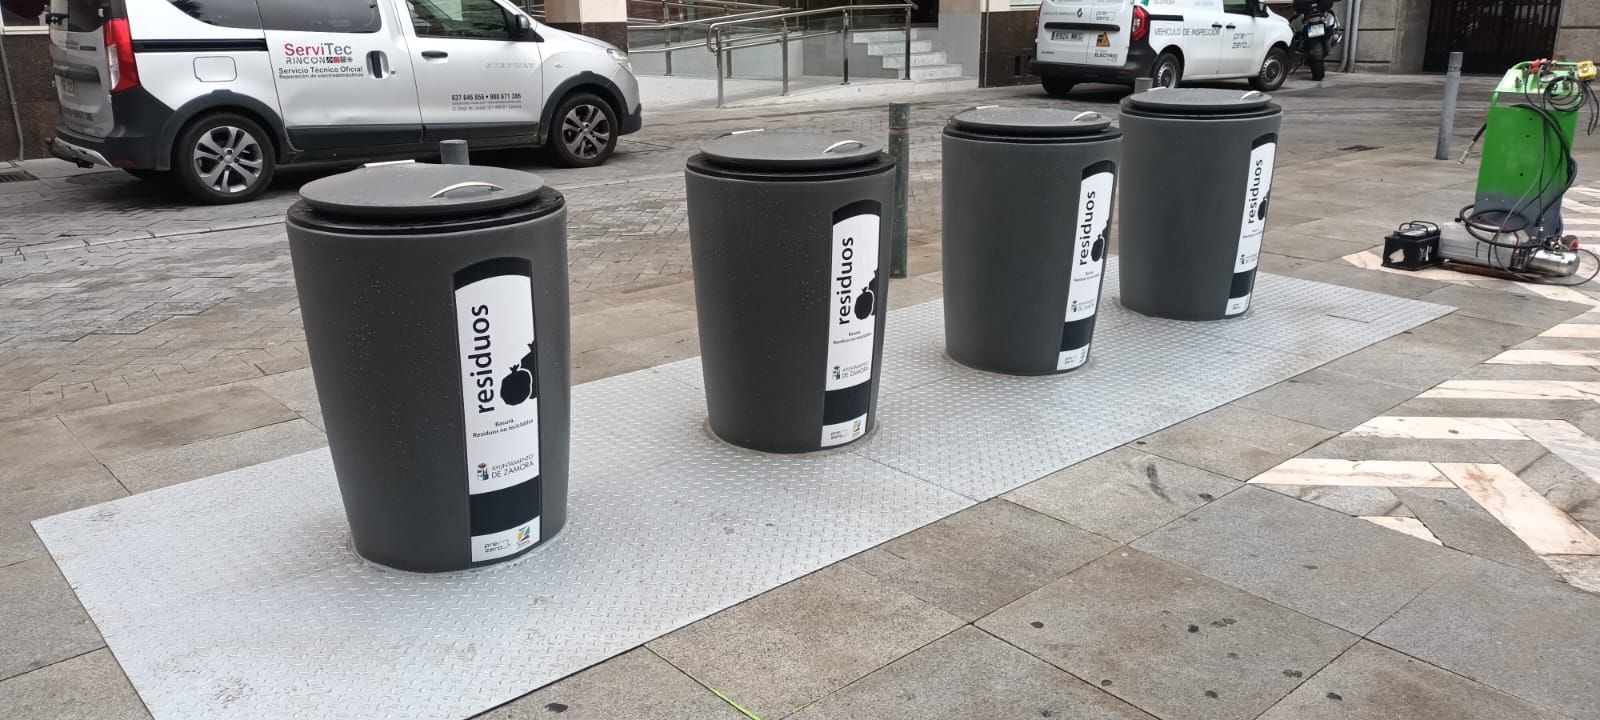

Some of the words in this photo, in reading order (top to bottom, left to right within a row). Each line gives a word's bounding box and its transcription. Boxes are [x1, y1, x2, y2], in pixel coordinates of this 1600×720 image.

[284, 42, 352, 56] ServiTec
[286, 57, 326, 65] RINCON
[279, 67, 309, 75] Servicio
[310, 65, 339, 73] Técnico
[340, 64, 363, 72] Oficial
[1248, 159, 1263, 224] residuos
[1080, 191, 1095, 265] residuos
[836, 237, 853, 325] residuos
[468, 304, 495, 413] residuos
[495, 418, 514, 427] Basura
[472, 430, 499, 438] Residuos
[491, 454, 534, 471] AYUNTAMIENTO
[491, 471, 502, 479] DE
[503, 461, 534, 476] ZAMORA
[484, 541, 498, 549] pre
[484, 545, 503, 553] zero
